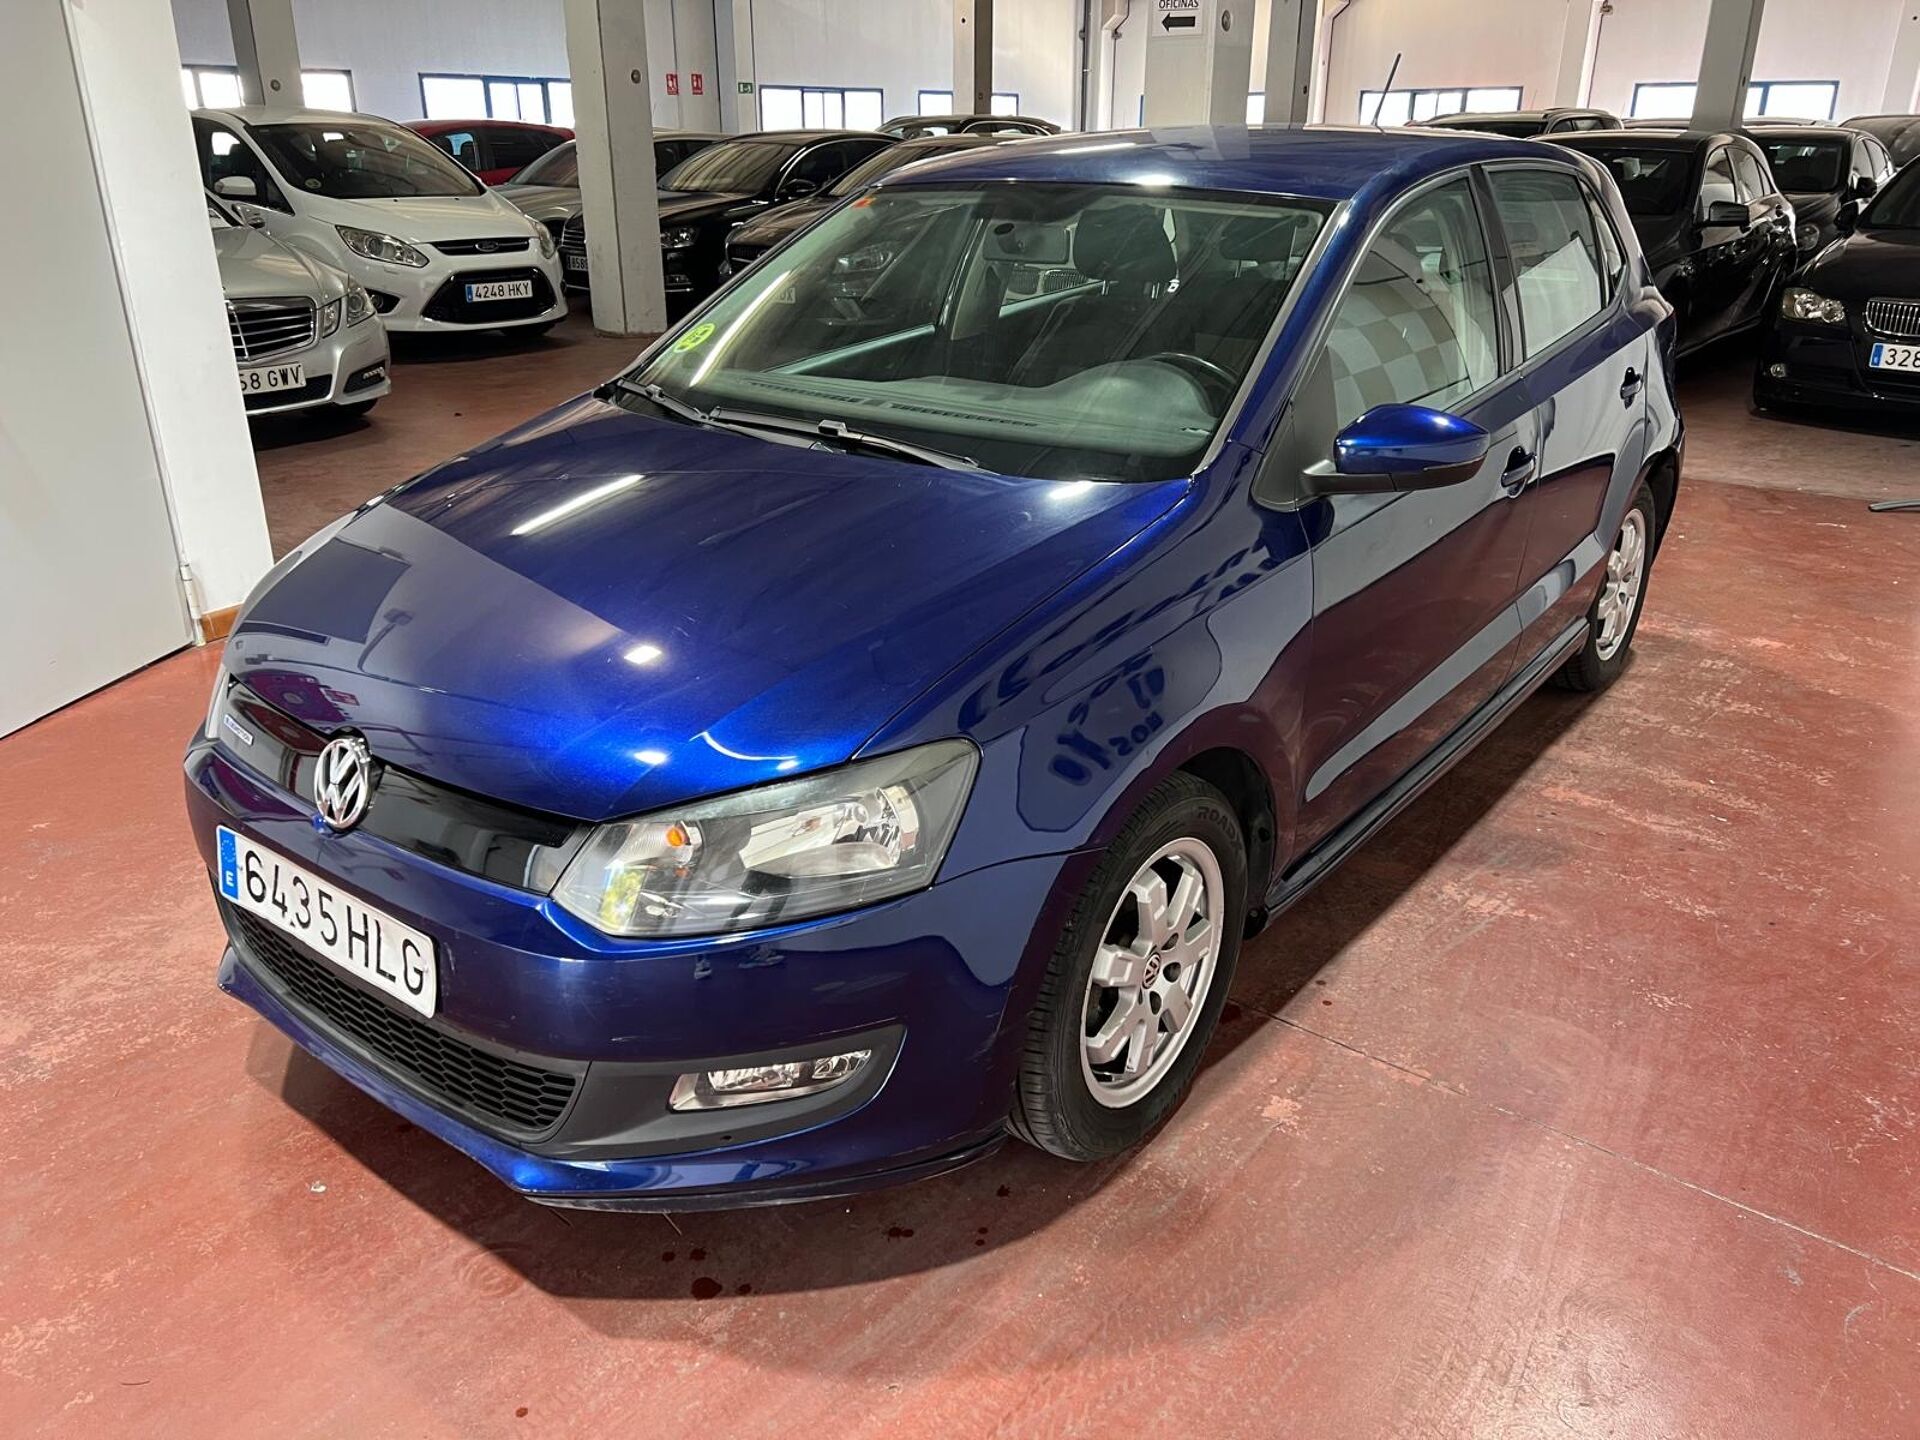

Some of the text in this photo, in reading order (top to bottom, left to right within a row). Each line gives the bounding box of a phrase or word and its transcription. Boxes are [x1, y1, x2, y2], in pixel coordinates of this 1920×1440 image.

[1159, 0, 1199, 8] OFICINAS
[475, 282, 529, 299] 4248 HKY
[267, 367, 299, 387] GWV
[225, 870, 234, 887] E
